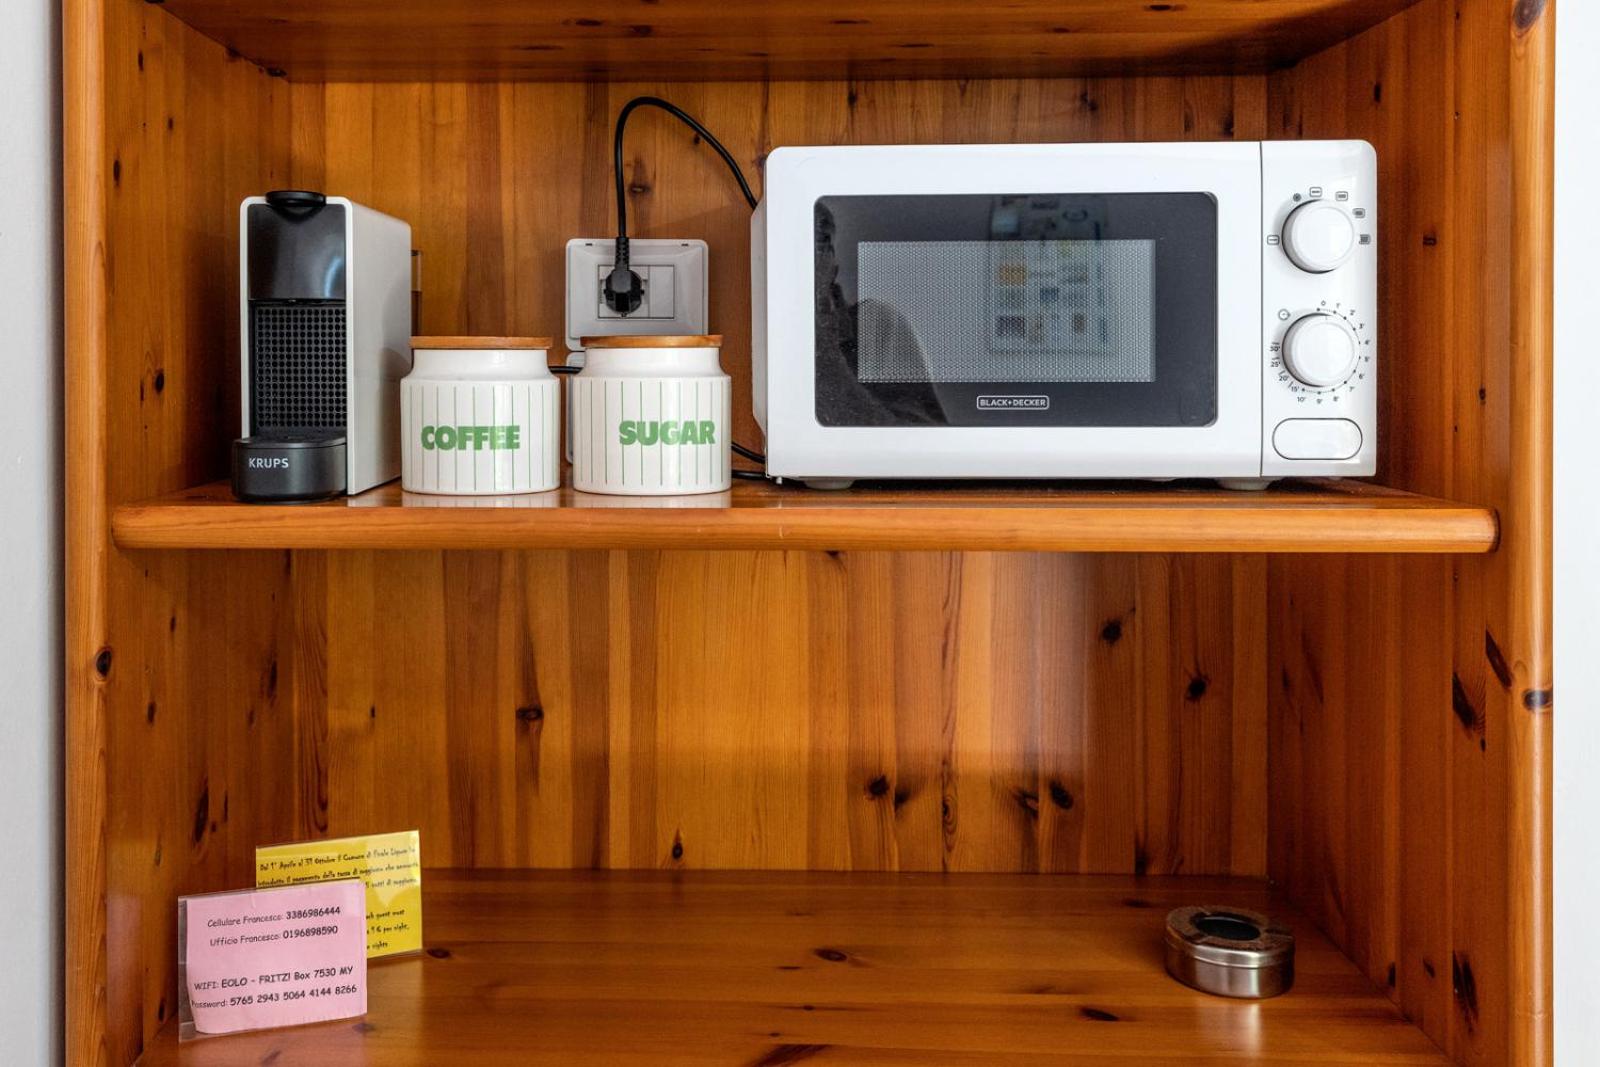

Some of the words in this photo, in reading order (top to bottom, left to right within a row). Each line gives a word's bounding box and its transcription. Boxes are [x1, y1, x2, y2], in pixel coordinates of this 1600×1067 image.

[421, 424, 521, 451] COFFEE
[618, 420, 716, 446] SUGAR
[248, 457, 289, 469] KRUPS
[207, 918, 241, 928] Cellulare
[242, 914, 283, 924] Francesco:
[286, 906, 341, 920] 3386986444
[210, 936, 238, 947] Ufficio
[240, 933, 280, 943] Francesco:
[282, 925, 338, 939] 0196898590
[193, 981, 219, 991] WIFI:
[221, 977, 248, 988] EOLO
[258, 972, 291, 985] FRITZ!
[294, 971, 311, 981] Box
[314, 967, 336, 977] 7530
[339, 966, 354, 976] MY
[230, 996, 254, 1006] 5765
[257, 992, 279, 1003] 2943
[283, 990, 306, 1000] 5064
[309, 987, 331, 997] 4144
[335, 984, 357, 995] 8266
